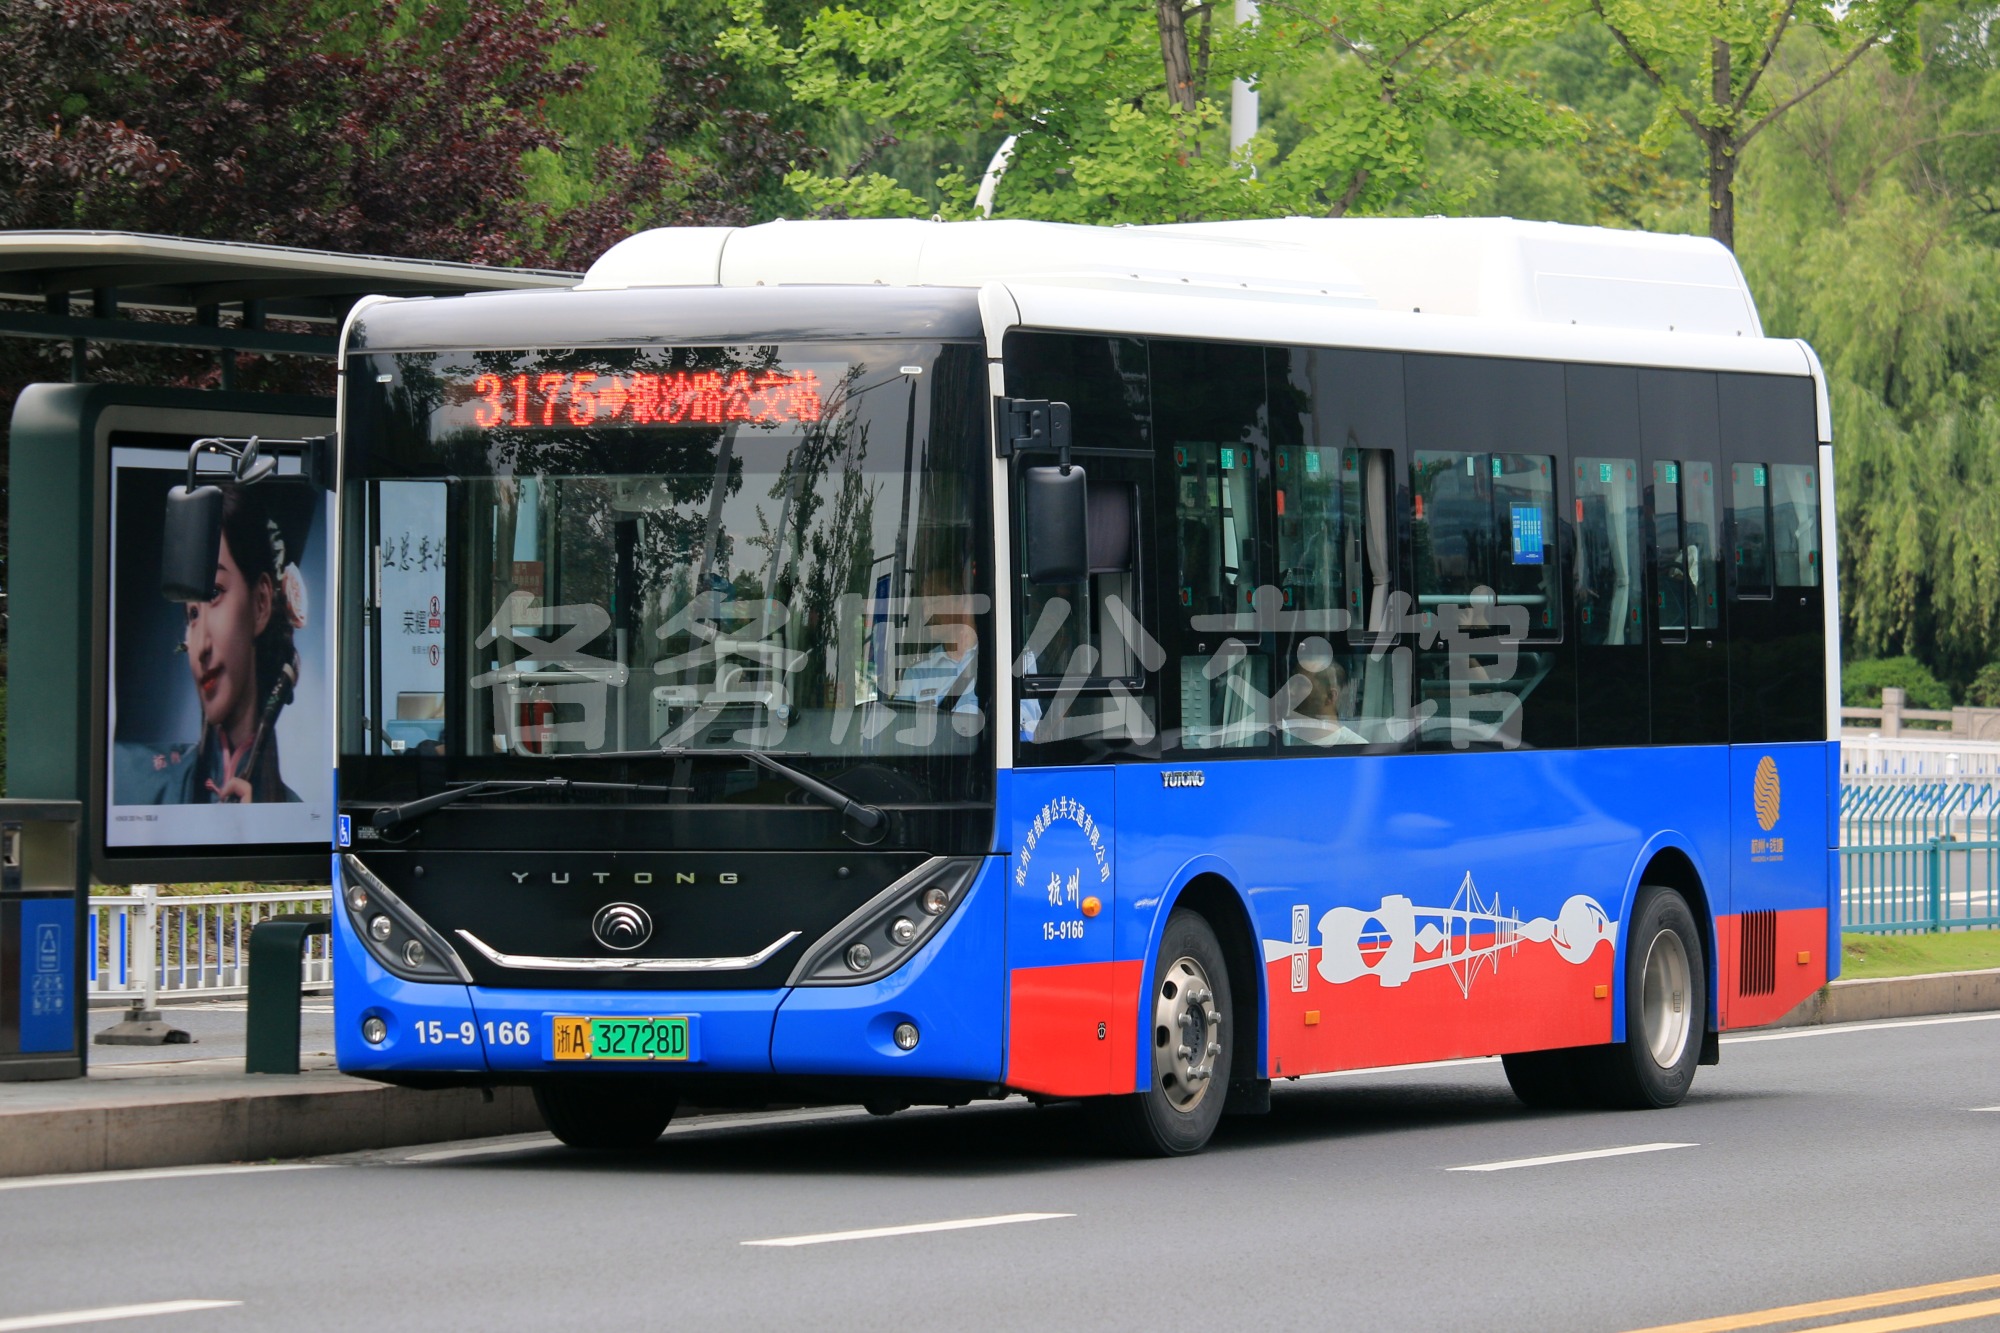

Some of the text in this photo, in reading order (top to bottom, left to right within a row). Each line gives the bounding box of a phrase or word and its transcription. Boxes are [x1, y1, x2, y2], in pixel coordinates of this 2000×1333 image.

[475, 370, 821, 427] 3175 银沙路公交站
[1161, 770, 1205, 787] YUTONG
[510, 871, 739, 885] YUTONG
[1046, 867, 1081, 909] 杭州
[1042, 919, 1084, 940] 15-9166
